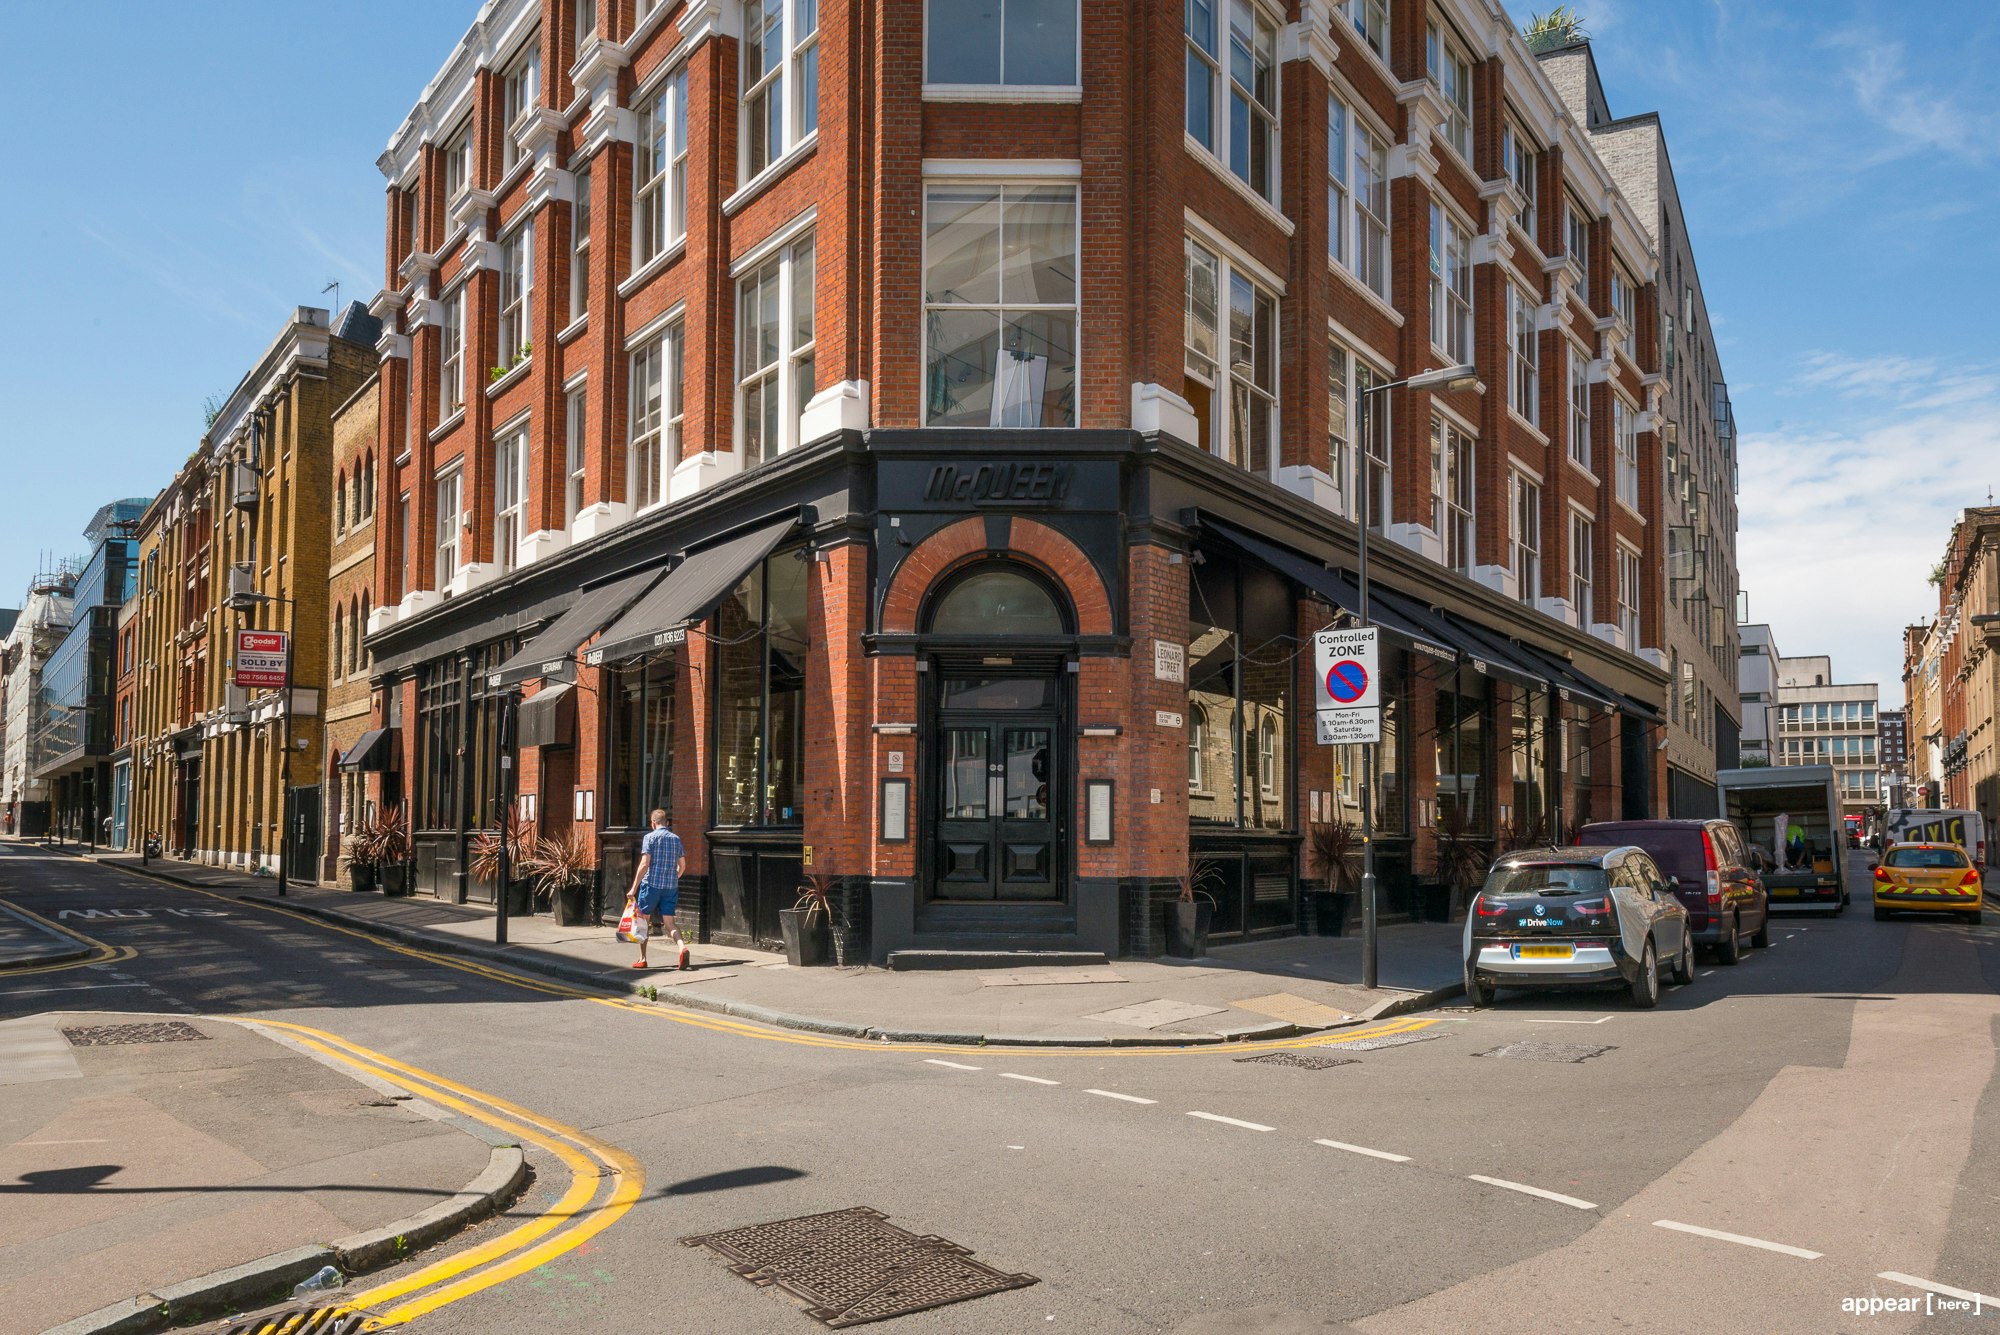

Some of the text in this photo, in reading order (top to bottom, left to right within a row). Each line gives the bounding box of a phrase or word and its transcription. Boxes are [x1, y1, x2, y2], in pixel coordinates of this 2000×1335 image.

[924, 463, 1077, 503] McQUEEN
[243, 635, 278, 649] goodsir
[654, 635, 662, 647] 020
[662, 632, 673, 645] 7036
[1318, 631, 1375, 645] Controlled
[587, 650, 603, 665] McQUEEN
[1157, 647, 1182, 663] LEONARD
[1329, 645, 1365, 658] ZONE
[240, 658, 267, 667] SOLD
[541, 661, 563, 674] RESTAURANT
[1160, 660, 1180, 674] STREET
[1335, 711, 1360, 719] Mon-Fri
[1333, 726, 1363, 734] Saturday
[804, 847, 812, 864] H
[1527, 918, 1564, 927] DriveNow
